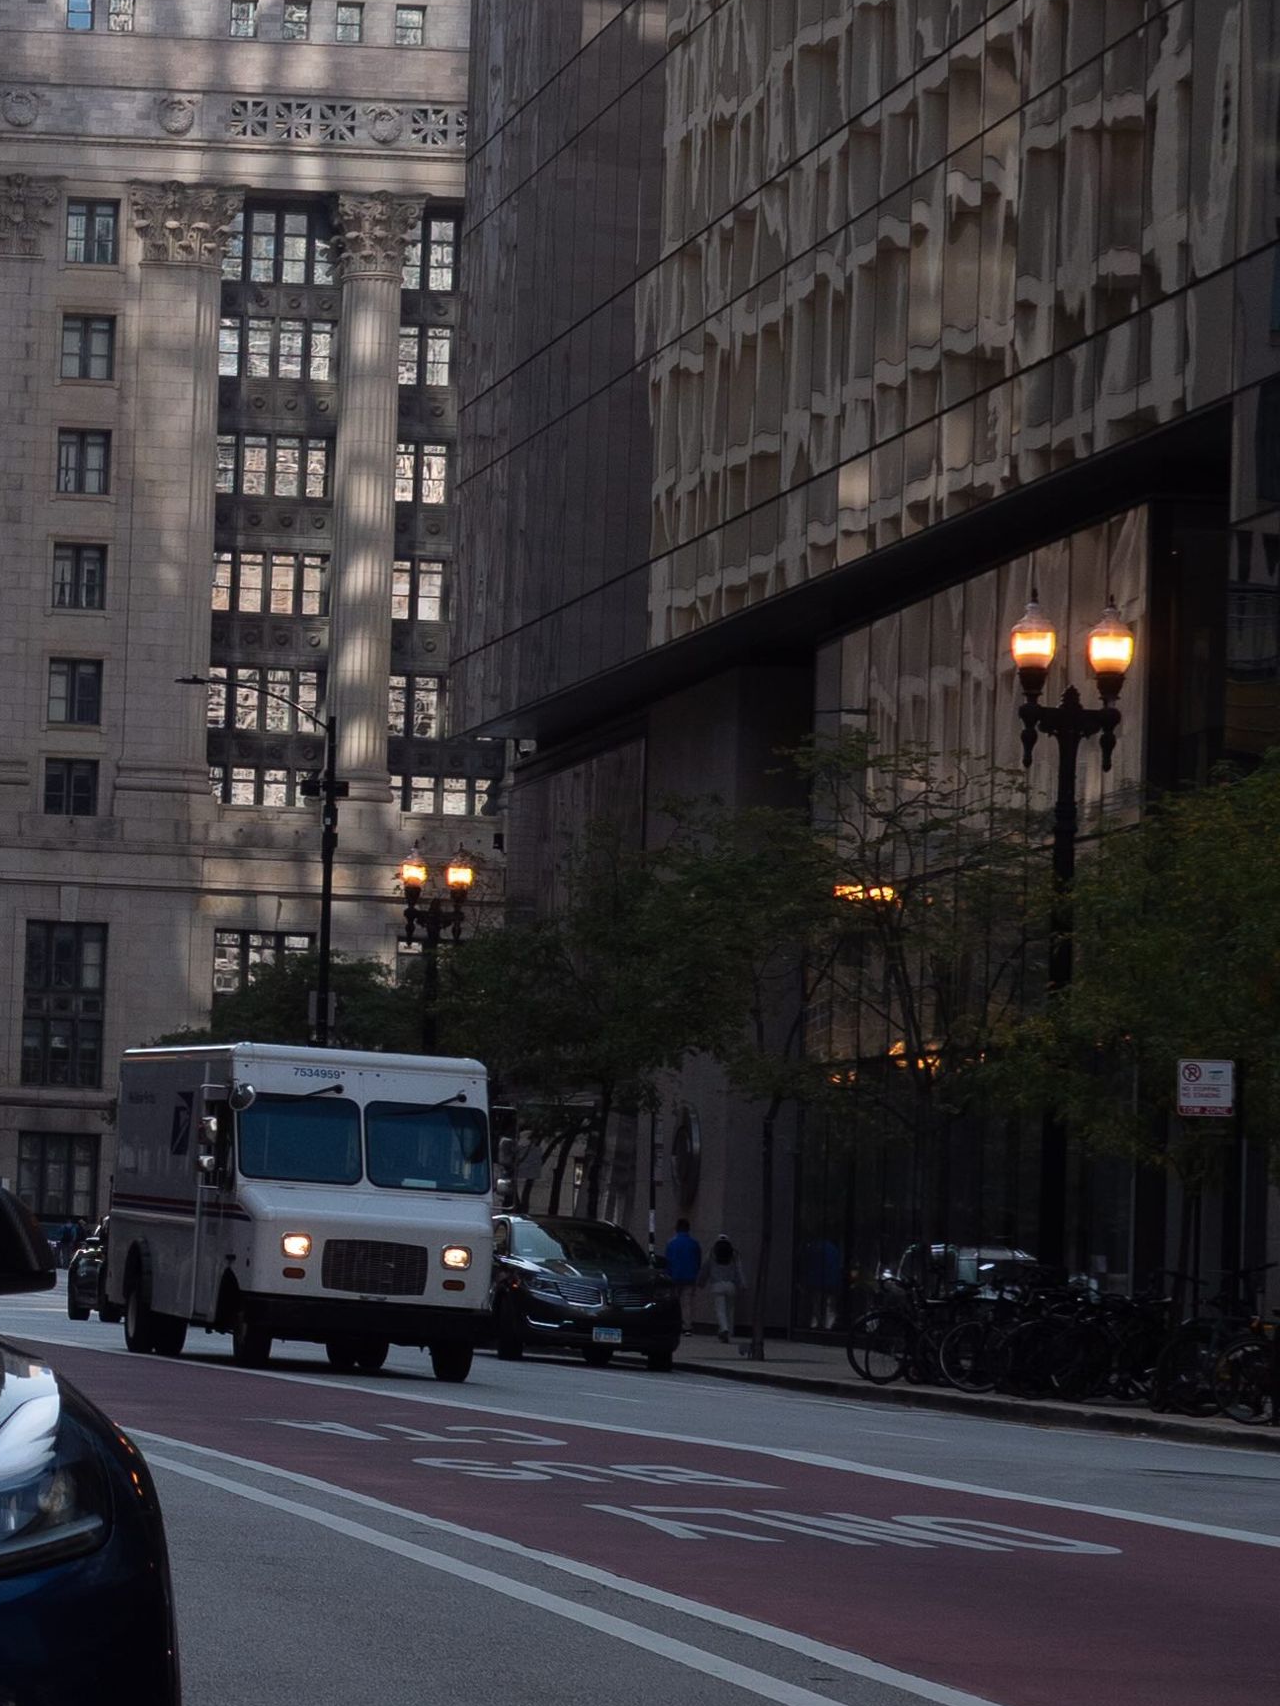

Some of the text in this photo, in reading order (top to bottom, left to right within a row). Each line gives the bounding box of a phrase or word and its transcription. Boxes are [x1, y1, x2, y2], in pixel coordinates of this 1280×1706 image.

[293, 1067, 341, 1080] 7534959
[411, 1456, 785, 1490] BUS
[583, 1504, 1122, 1555] ONLY
